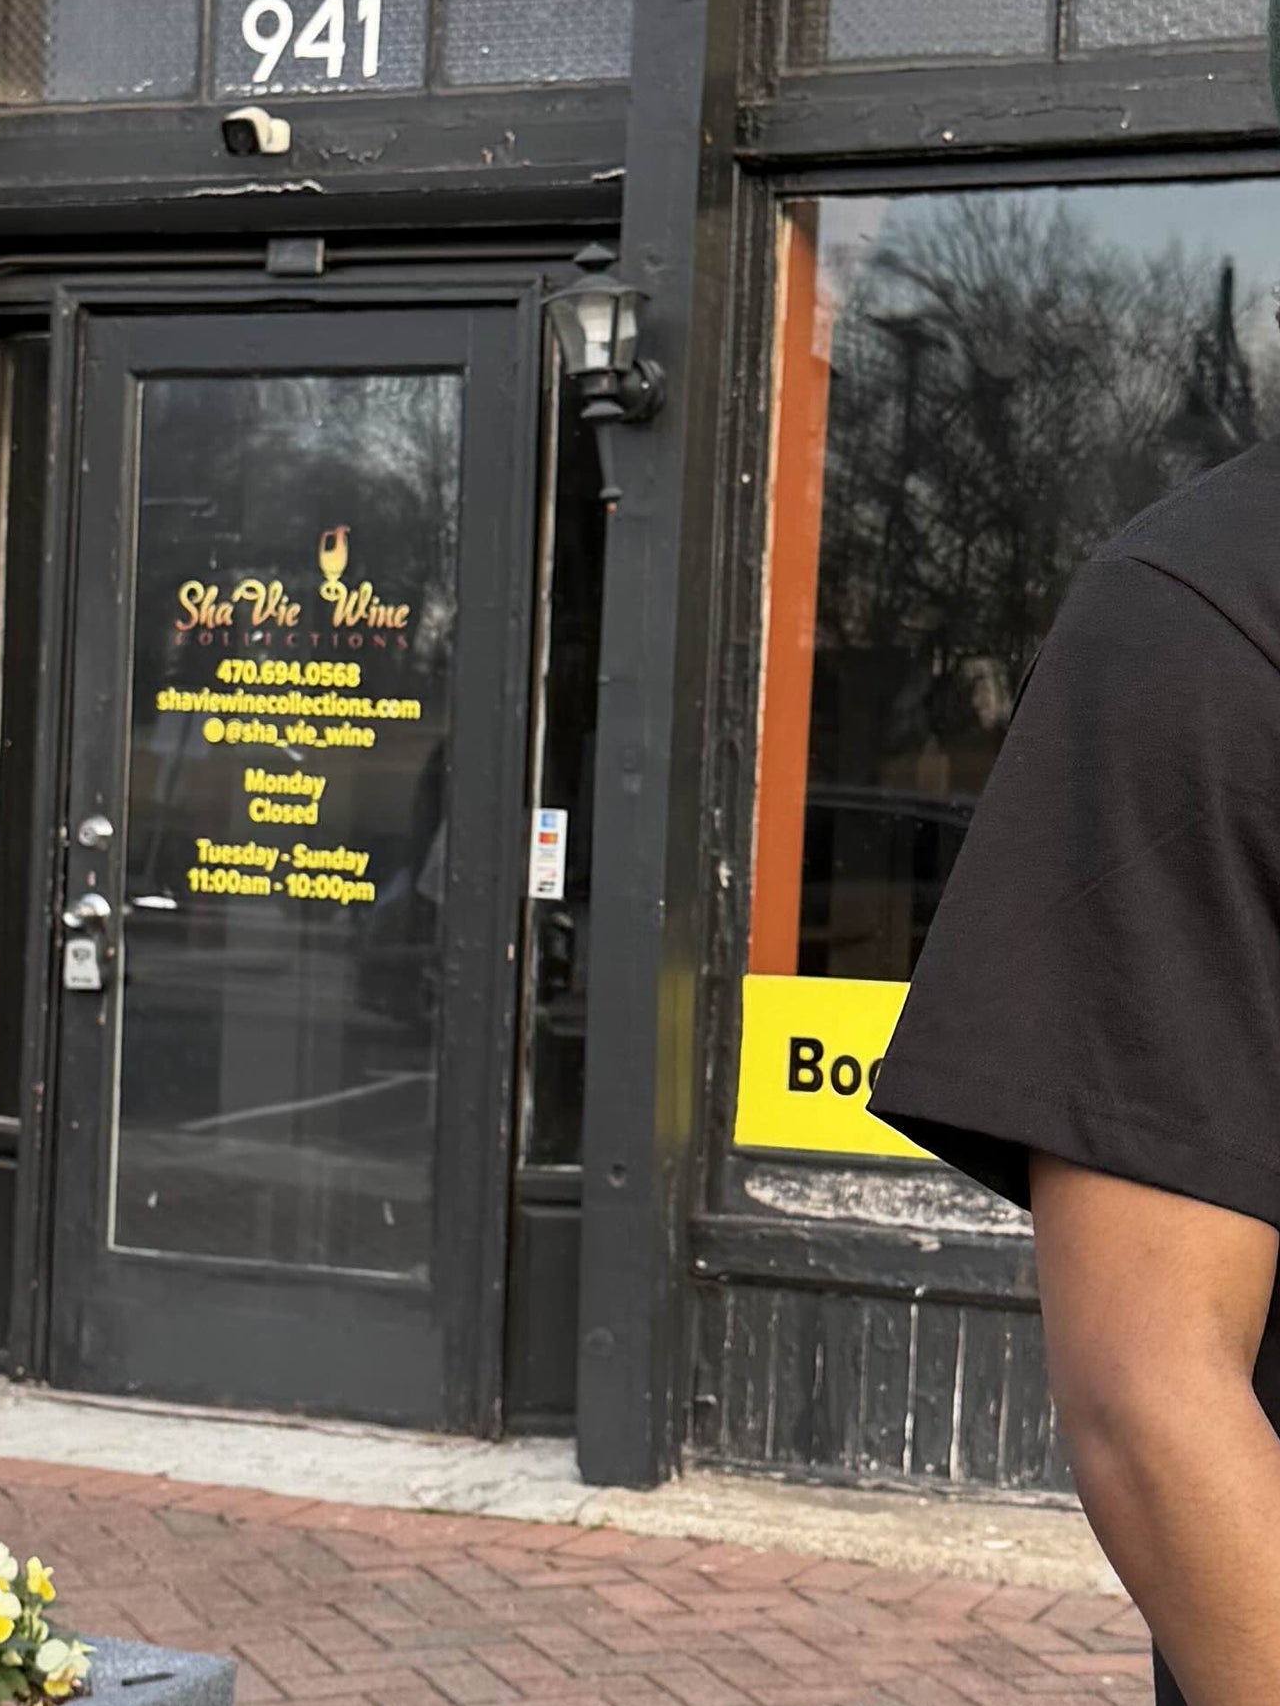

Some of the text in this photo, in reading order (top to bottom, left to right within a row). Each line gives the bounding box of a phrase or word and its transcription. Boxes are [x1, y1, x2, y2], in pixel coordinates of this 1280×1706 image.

[175, 579, 410, 631] Sha Vie Wine
[216, 659, 361, 687] 470.694.0568
[156, 686, 421, 719] shaviewinecollections.com
[244, 768, 326, 800] Monday
[249, 797, 319, 824] Closed
[196, 838, 279, 872] Tuesday
[292, 843, 370, 877] Sunday
[188, 868, 271, 896] 11:00am
[285, 873, 376, 905] 10:00pm
